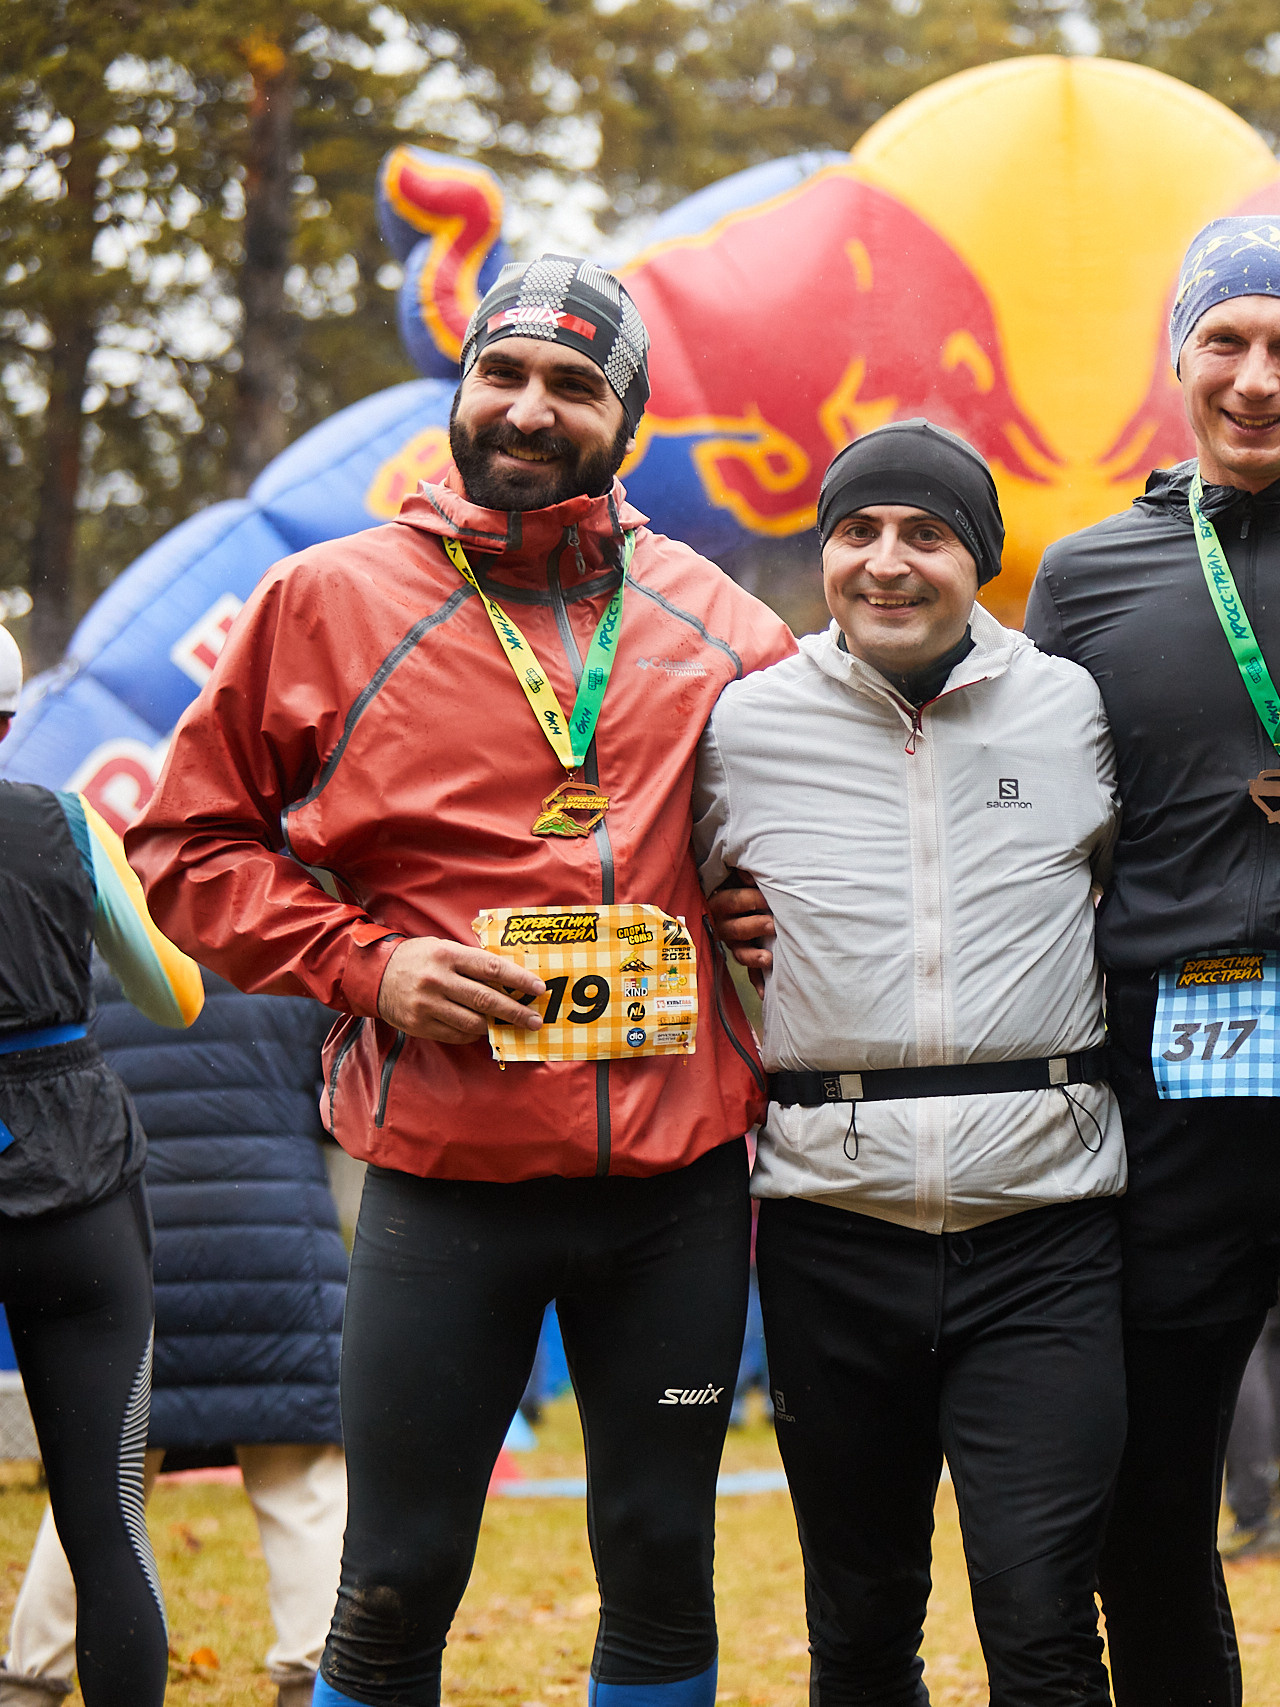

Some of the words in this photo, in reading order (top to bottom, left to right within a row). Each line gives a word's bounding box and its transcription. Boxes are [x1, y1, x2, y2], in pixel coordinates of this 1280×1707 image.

[500, 307, 567, 328] SWIX
[650, 656, 704, 669] Columbia
[665, 669, 707, 677] TITANIUM
[508, 916, 597, 930] БУРЕВЕСТНИК
[504, 927, 596, 944] КРОСС-ТРЕЙЛ
[617, 924, 645, 938] СПОРТ
[628, 932, 652, 944] СОЮЗ
[661, 952, 692, 960] 2021
[1184, 956, 1264, 972] БУРЕВЕСТНИК
[1179, 967, 1262, 986] КРОСС-ТРЕЙЛ
[624, 987, 648, 997] KIND
[629, 1002, 644, 1017] NL
[1161, 1019, 1258, 1062] 317
